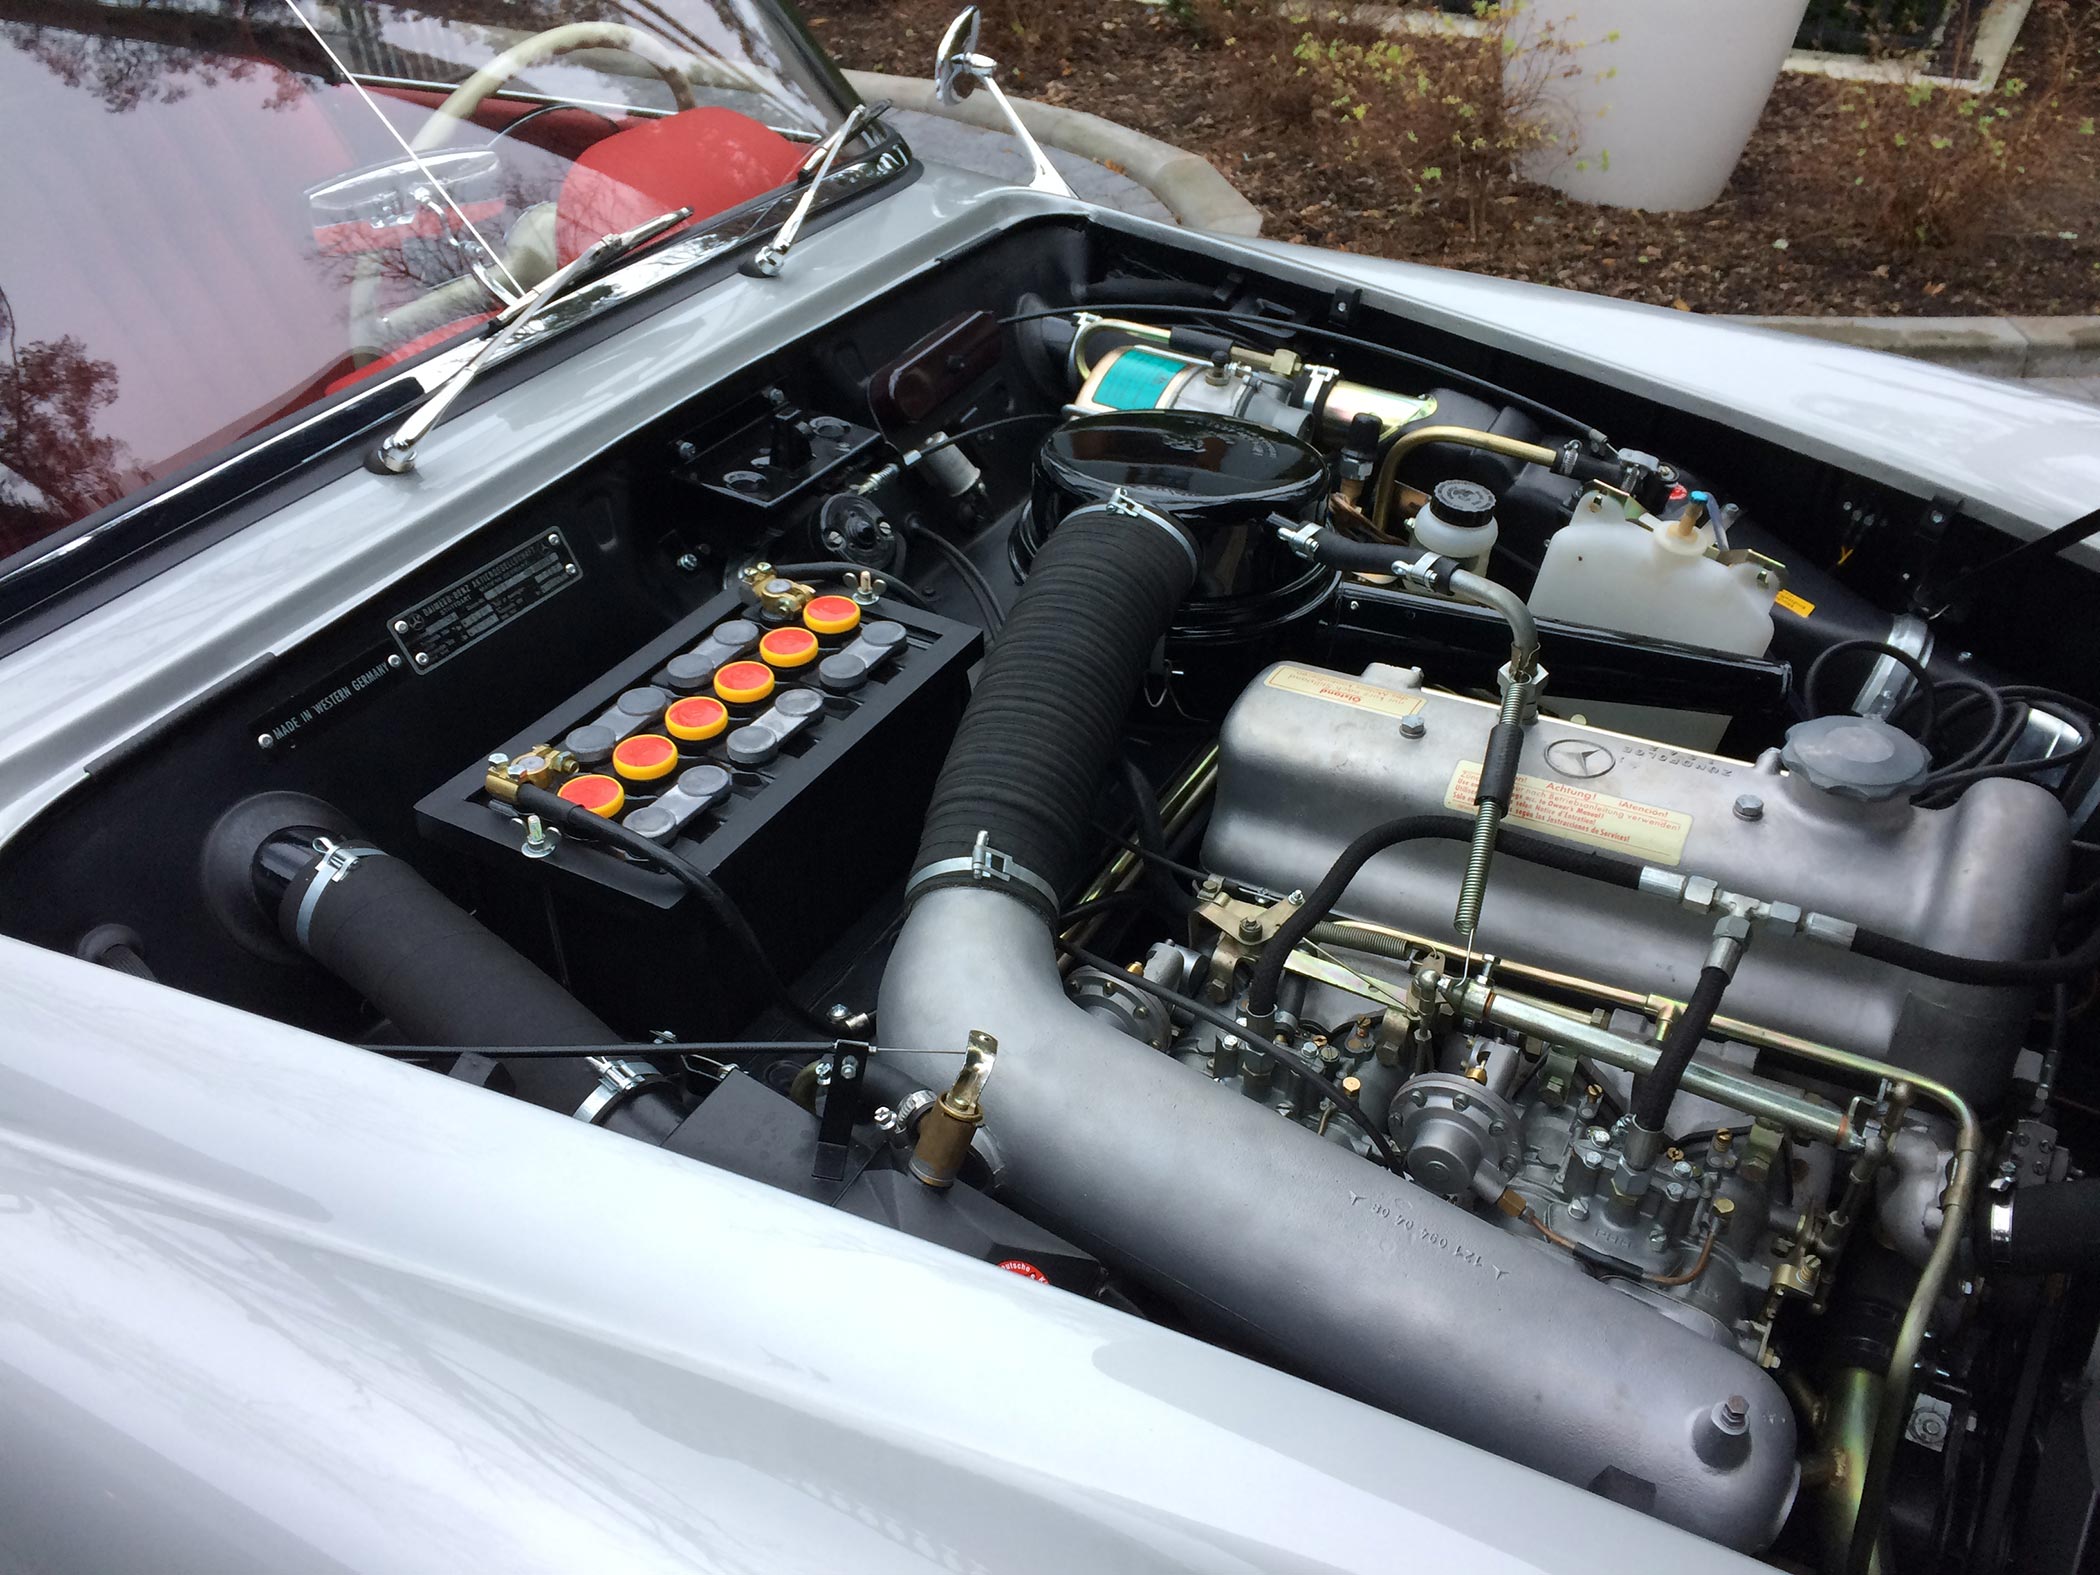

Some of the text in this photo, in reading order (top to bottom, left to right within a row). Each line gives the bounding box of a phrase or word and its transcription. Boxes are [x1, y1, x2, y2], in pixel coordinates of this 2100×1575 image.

[272, 662, 389, 740] MADE IN WESTERN GERMANY
[1546, 782, 1597, 800] Achtung!
[1526, 787, 1546, 798] nach
[1548, 793, 1624, 819] Betriebsanleitung
[1627, 815, 1681, 831] verwenden!
[1395, 1215, 1415, 1231] 04
[1420, 1228, 1448, 1249] 094
[1453, 1245, 1482, 1267] 121
